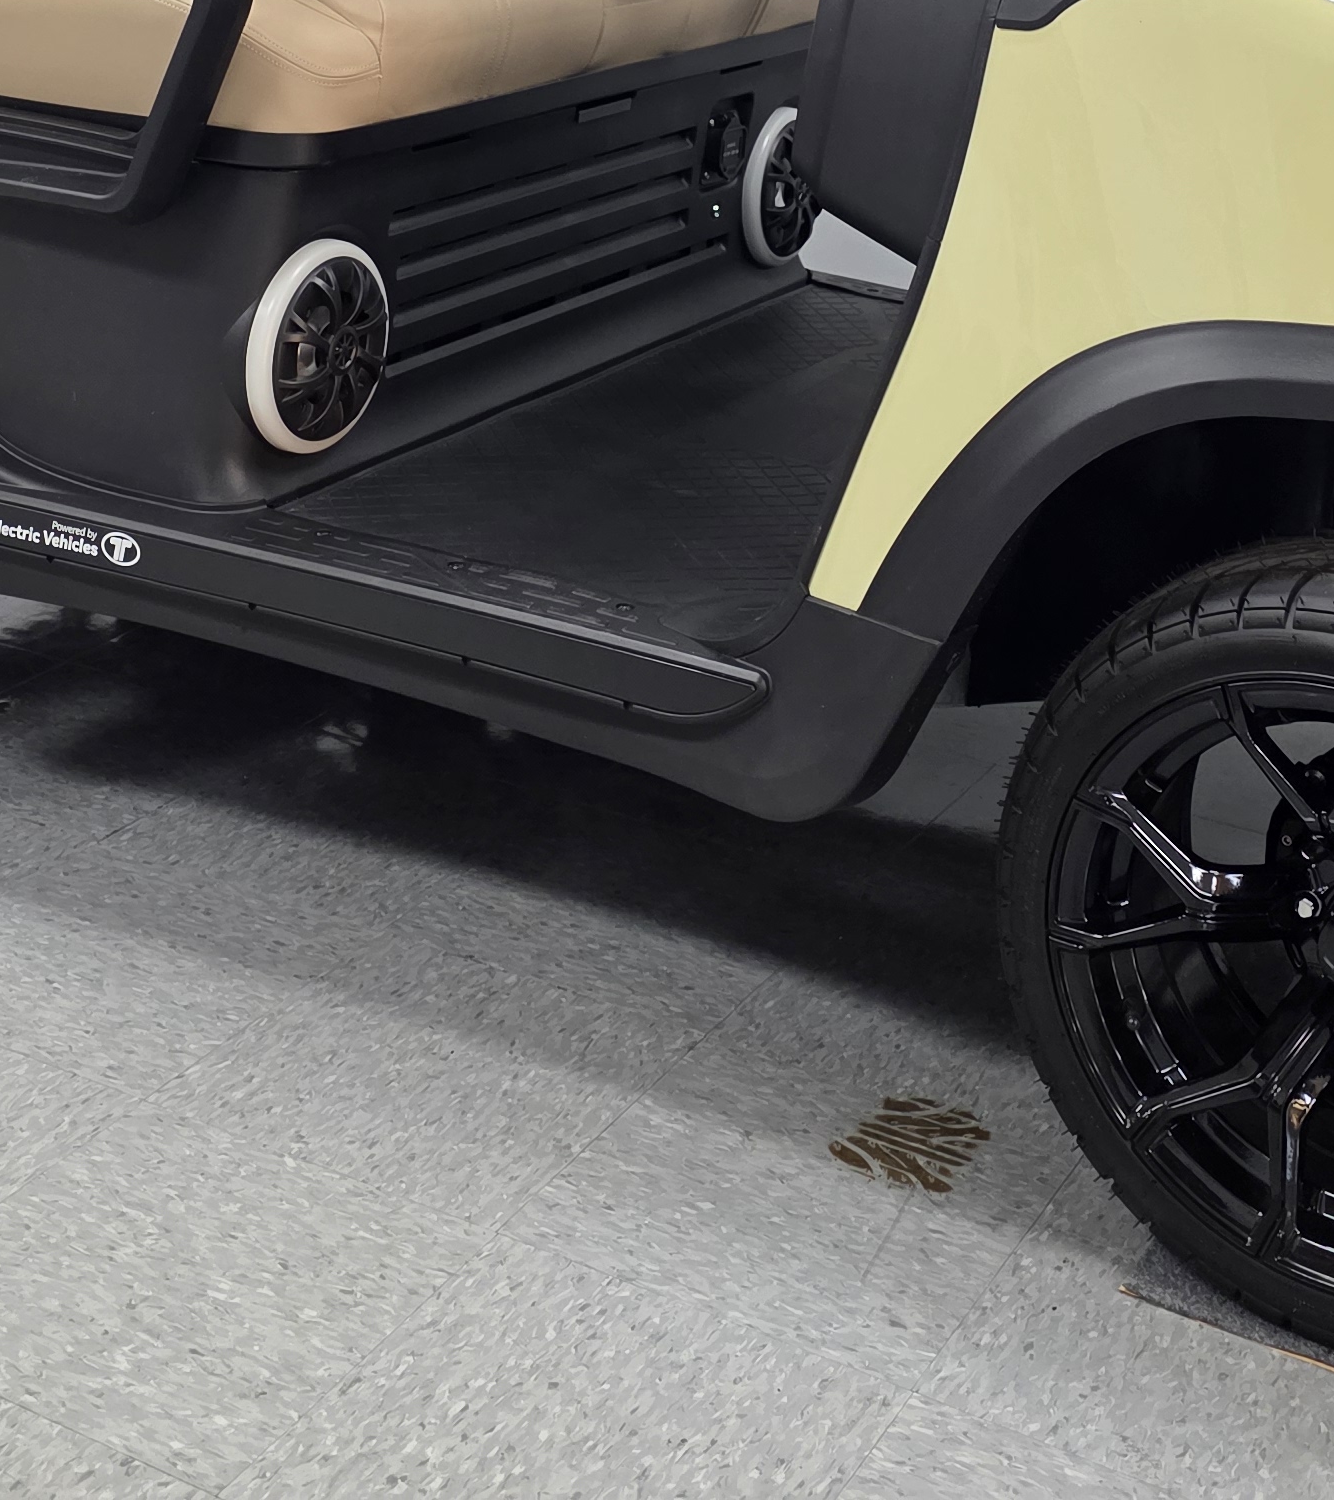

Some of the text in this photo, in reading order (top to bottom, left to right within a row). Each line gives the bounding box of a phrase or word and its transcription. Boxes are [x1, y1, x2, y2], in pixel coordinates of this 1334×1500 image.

[51, 520, 98, 541] Powered by
[42, 529, 99, 557] Vehicles
